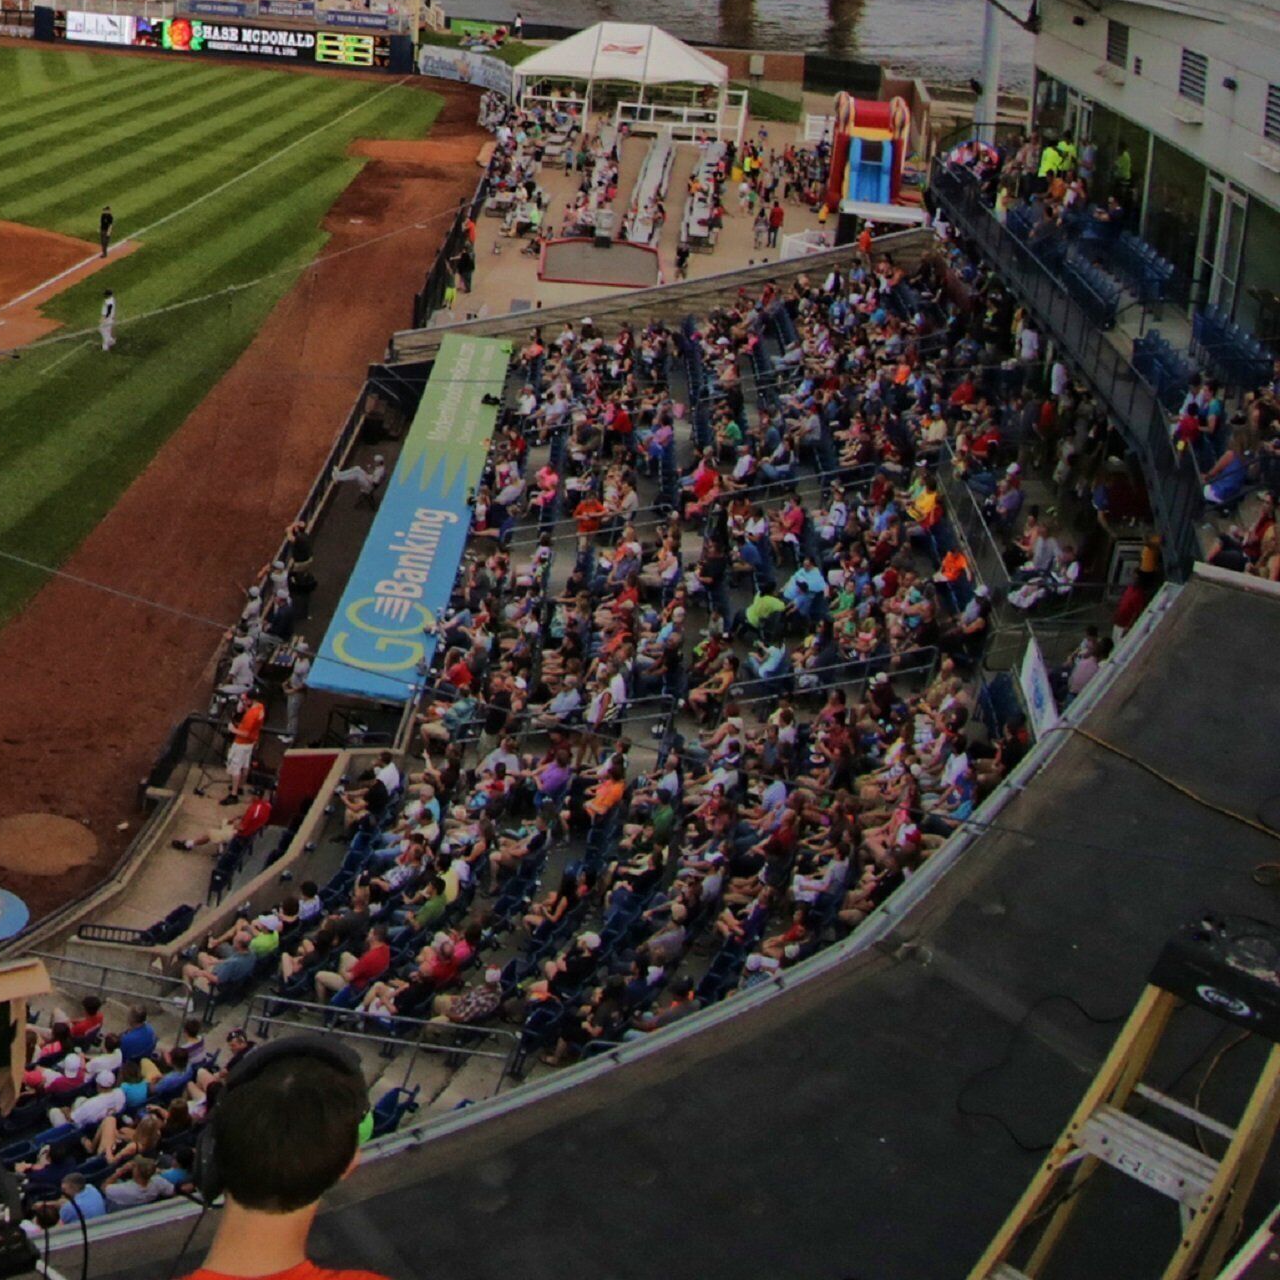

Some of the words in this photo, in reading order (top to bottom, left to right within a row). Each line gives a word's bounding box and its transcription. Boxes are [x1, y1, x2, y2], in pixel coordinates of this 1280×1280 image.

[192, 24, 239, 40] CHASE
[241, 29, 315, 48] MCDONALD
[373, 507, 460, 600] Banking
